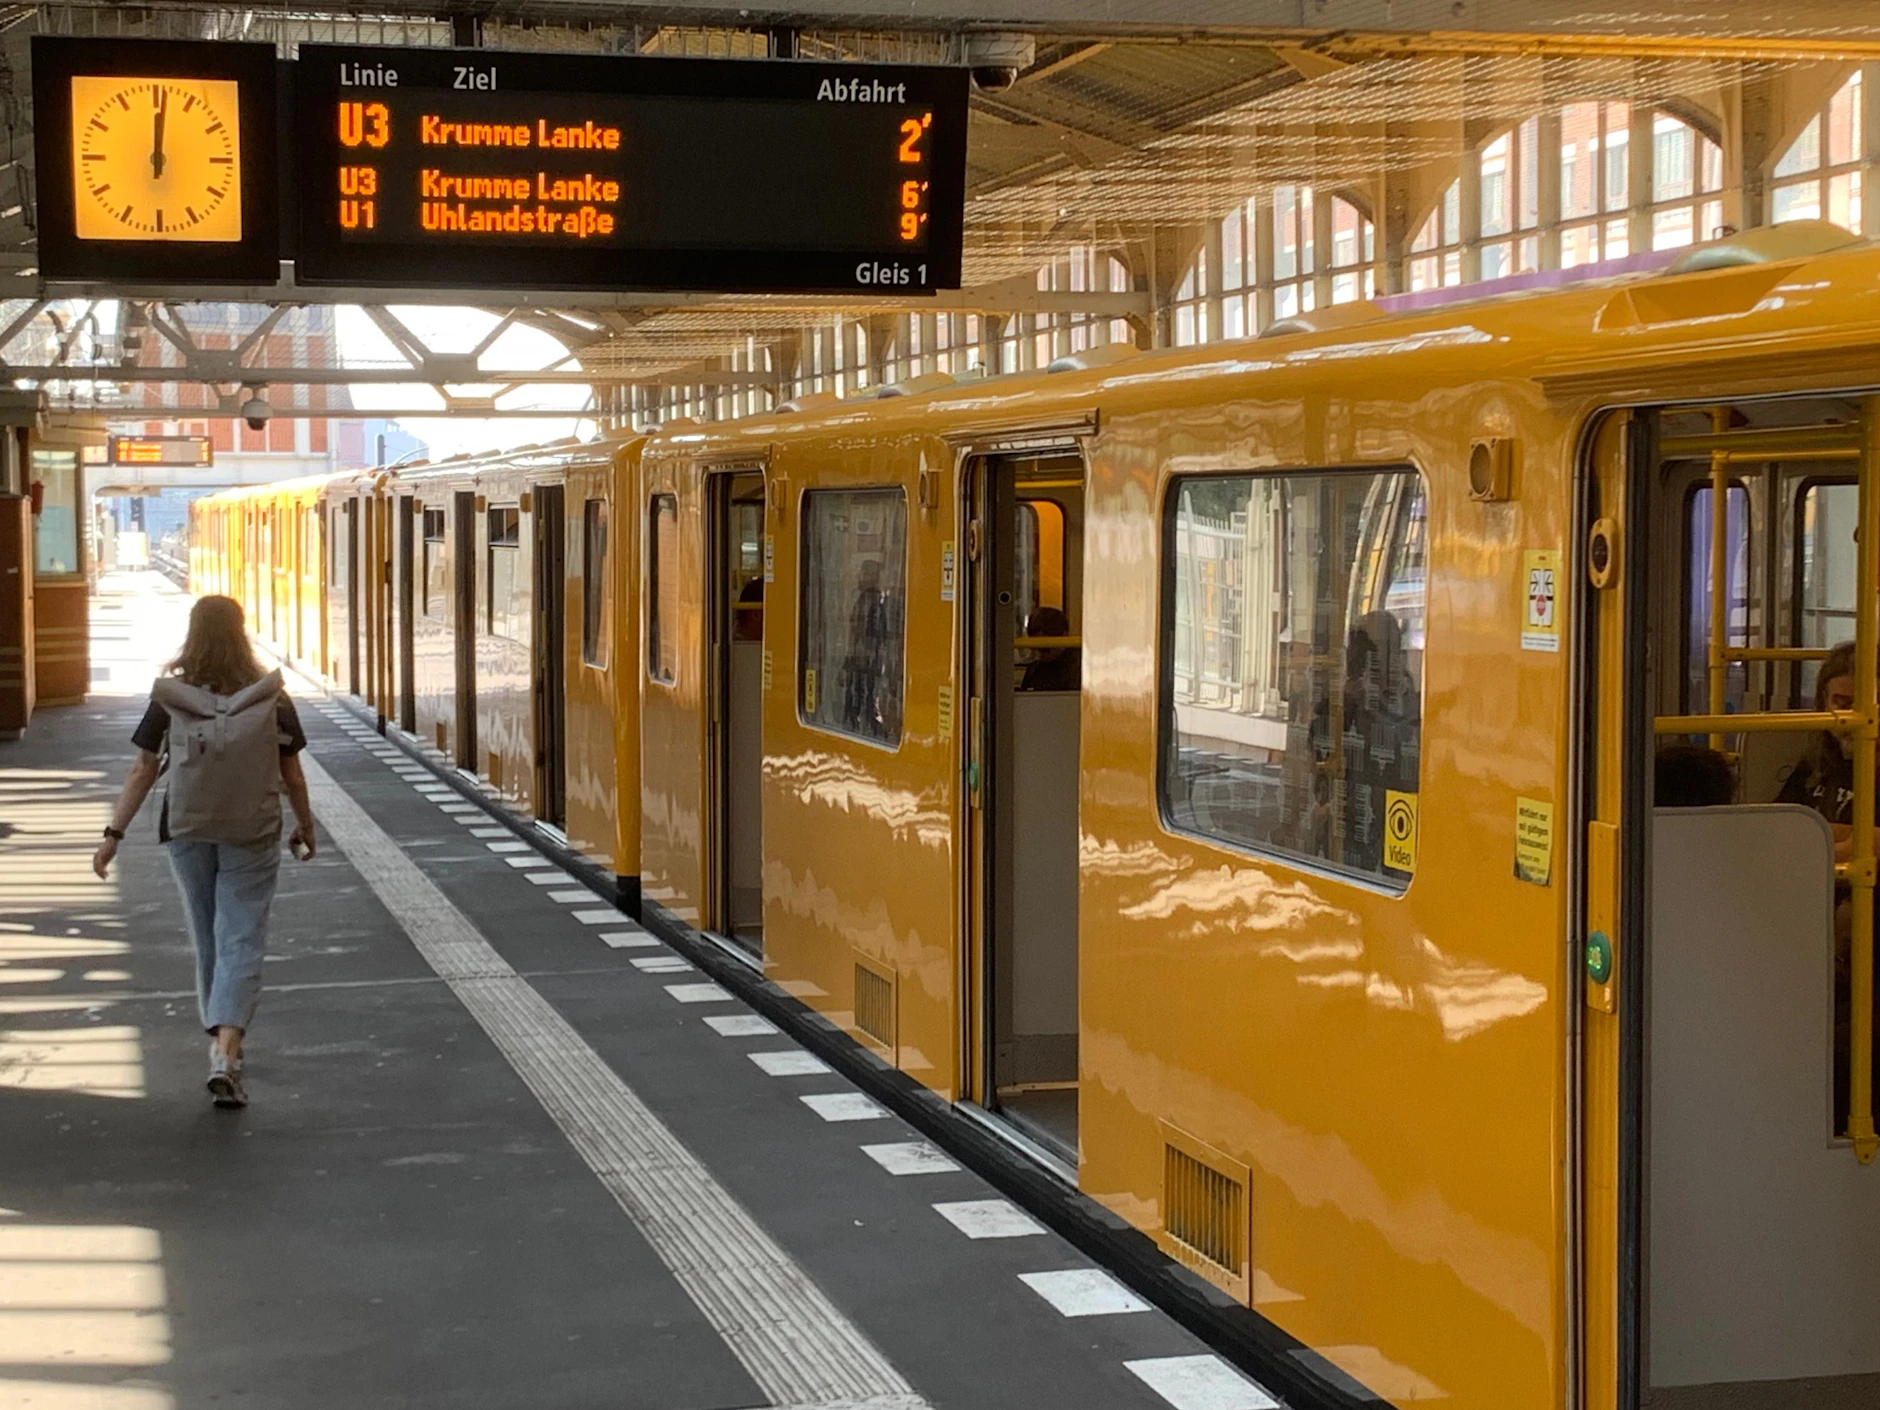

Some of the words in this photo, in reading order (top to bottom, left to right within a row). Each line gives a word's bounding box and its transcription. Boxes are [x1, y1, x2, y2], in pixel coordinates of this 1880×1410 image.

[340, 63, 398, 87] Linie
[453, 67, 497, 90] Ziel
[816, 78, 906, 104] Abfahrt
[339, 102, 389, 147] U3
[422, 115, 530, 146] Krumme
[538, 119, 620, 150] Lanke
[340, 167, 376, 195] U3
[422, 169, 530, 200] Krumme
[538, 172, 619, 202] Lanke
[340, 200, 374, 229] U1
[422, 202, 614, 238] Uhlandstraße
[855, 262, 910, 285] Gleis
[918, 264, 927, 285] 1
[1389, 844, 1411, 867] Video
